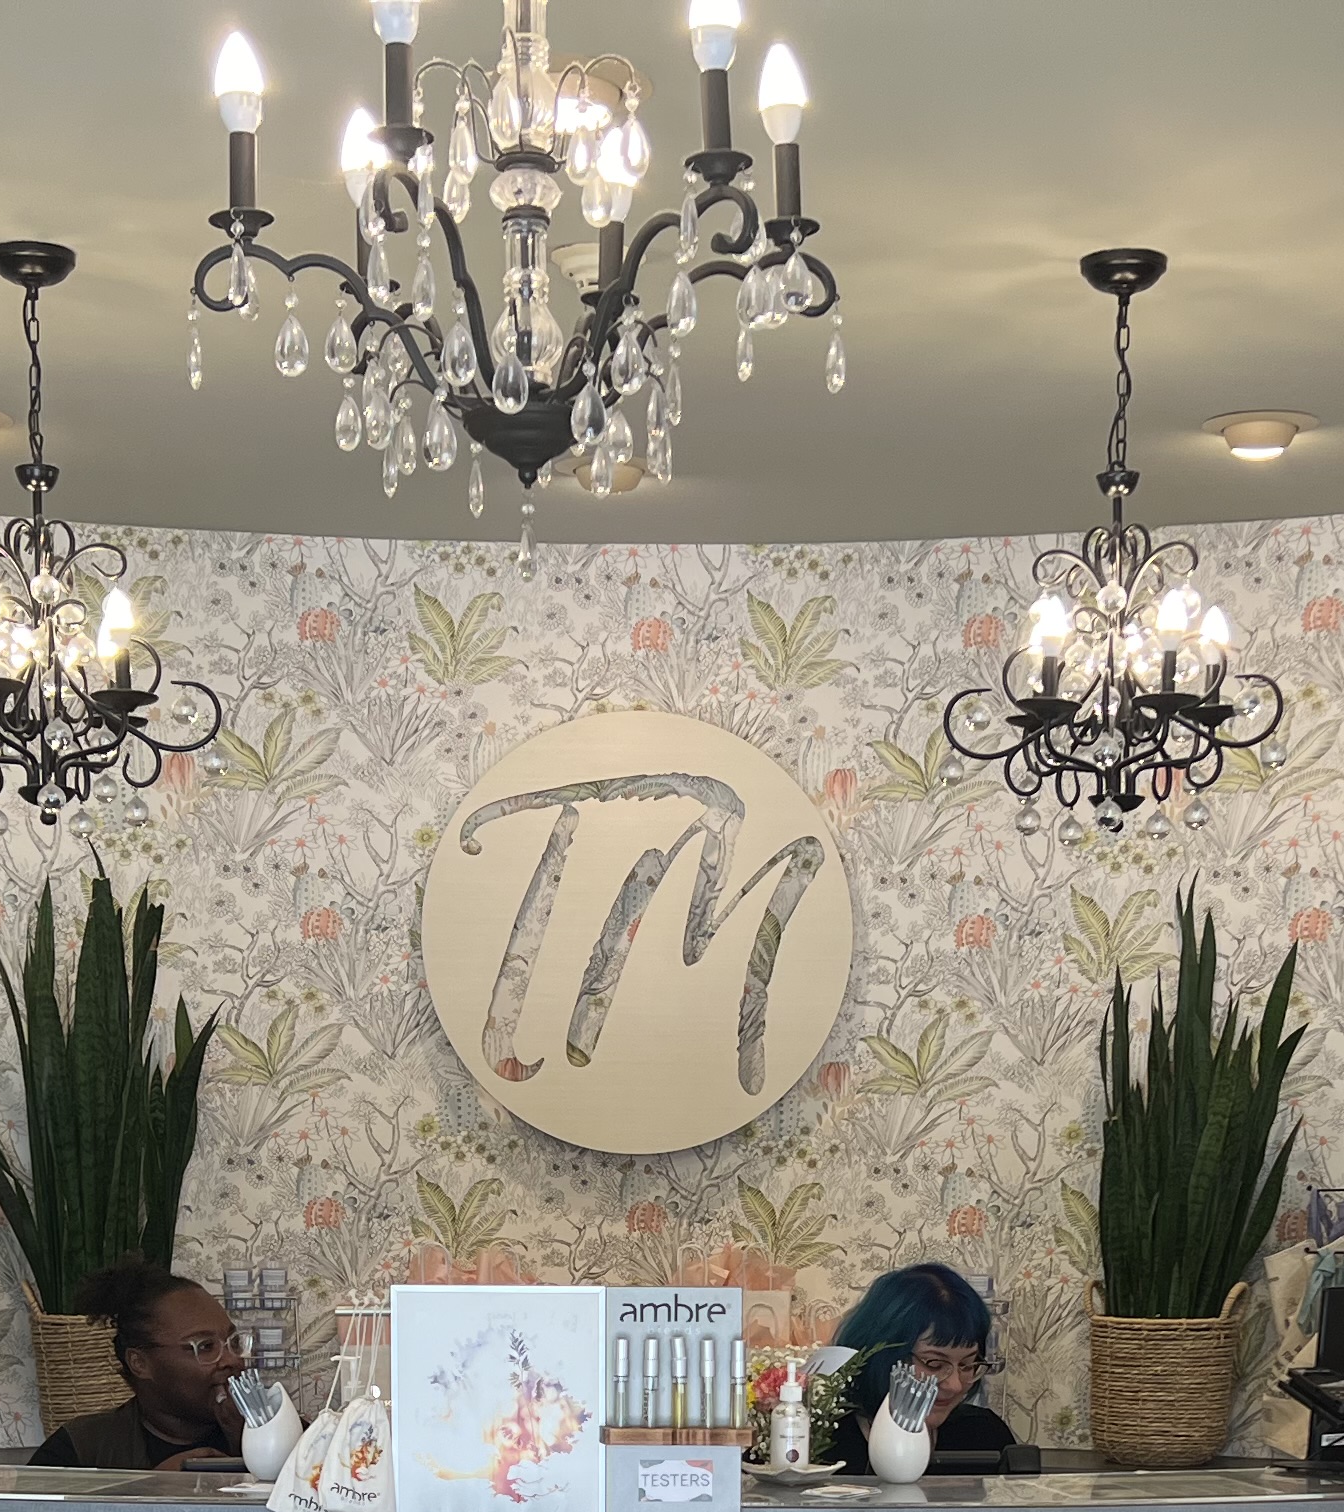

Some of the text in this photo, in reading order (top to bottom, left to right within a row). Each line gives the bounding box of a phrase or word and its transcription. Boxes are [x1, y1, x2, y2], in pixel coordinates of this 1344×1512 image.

[460, 772, 825, 1096] TM
[619, 1293, 726, 1323] ambre
[330, 1482, 378, 1502] ambre
[640, 1473, 710, 1488] TESTERS
